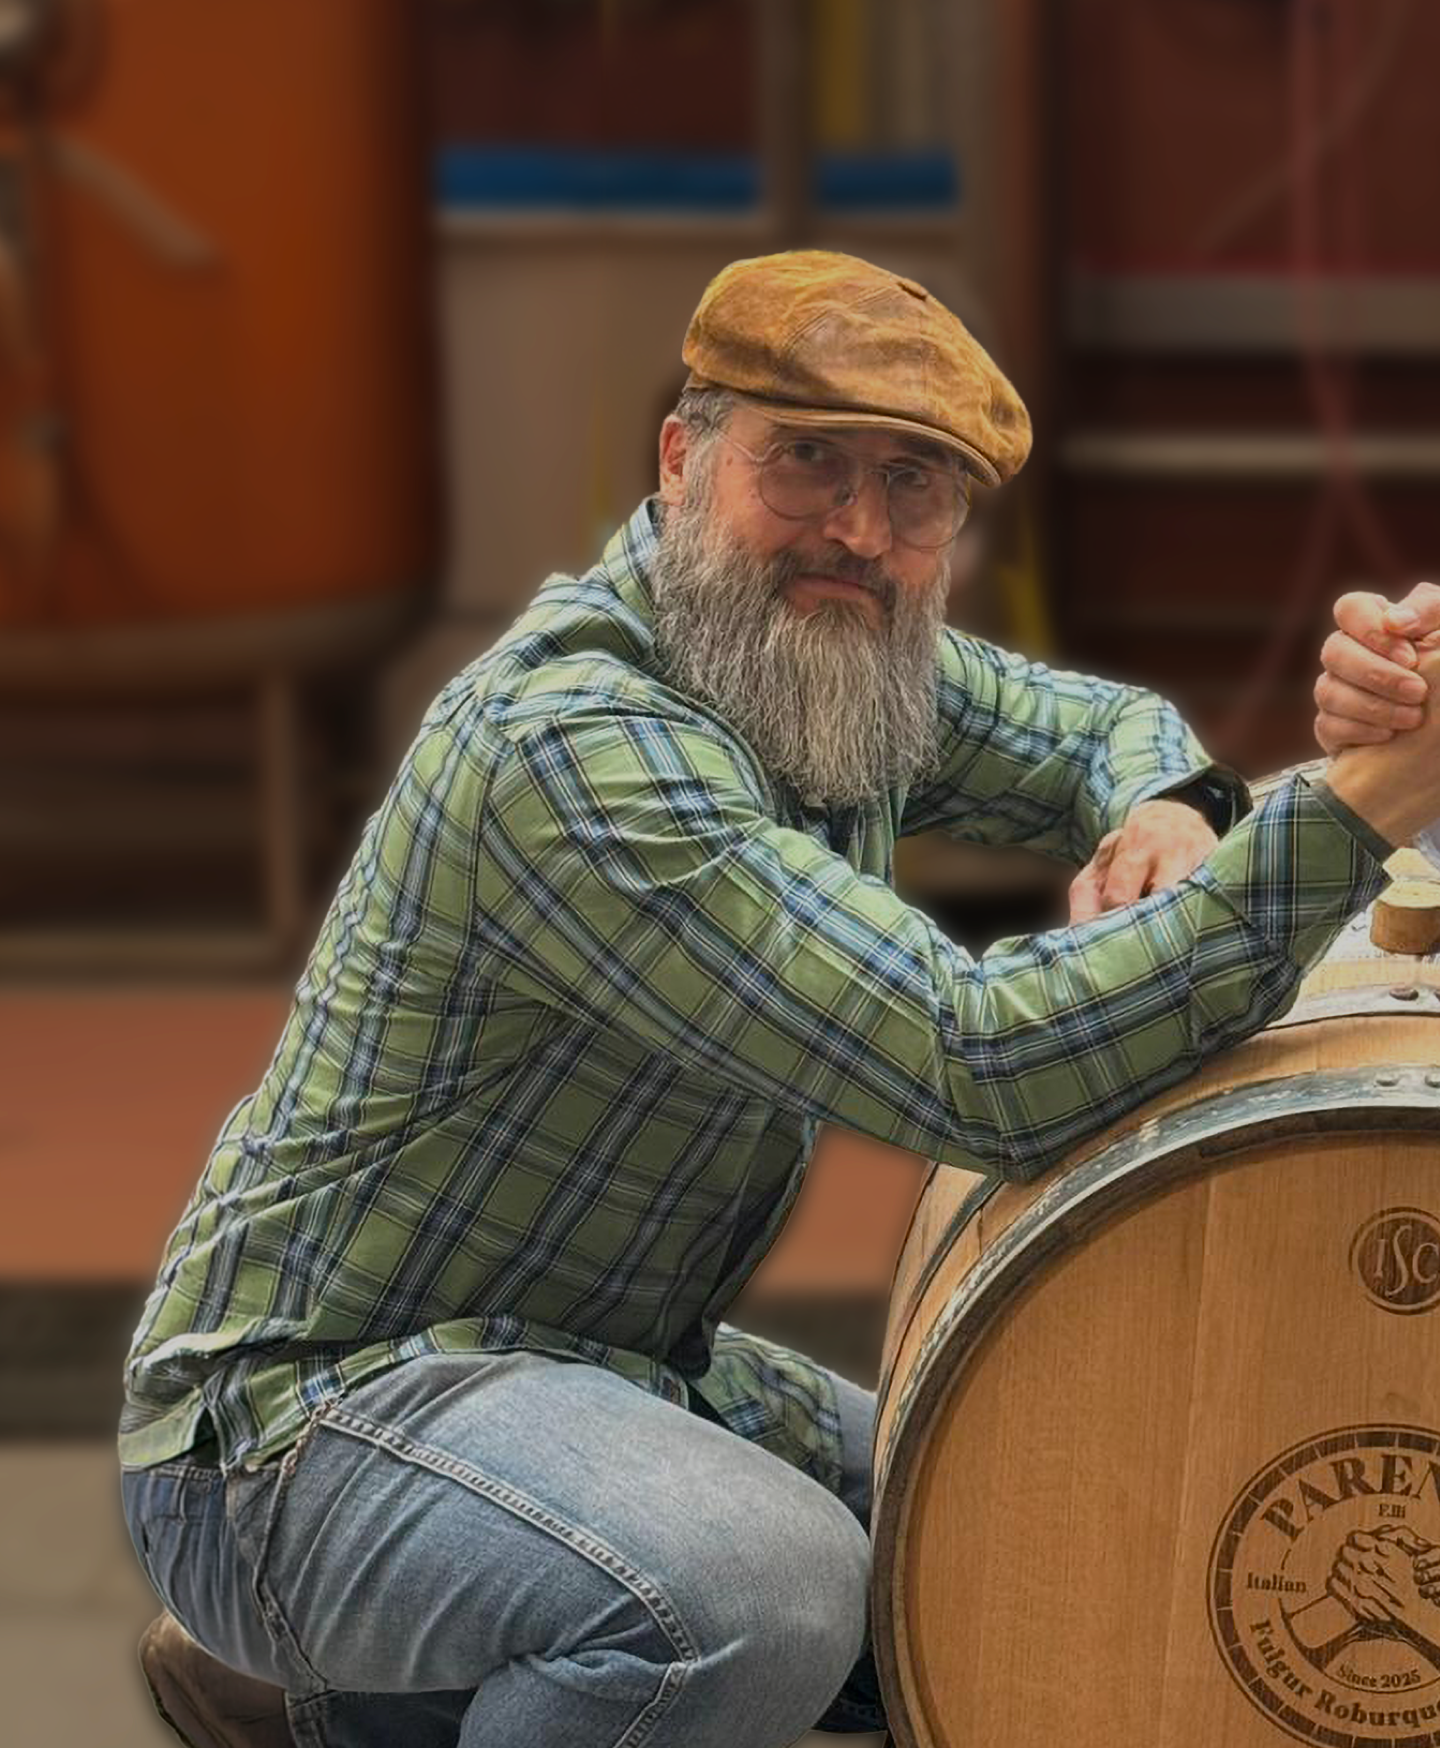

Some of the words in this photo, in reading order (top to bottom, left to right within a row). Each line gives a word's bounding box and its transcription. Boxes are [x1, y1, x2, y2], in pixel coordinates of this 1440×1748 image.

[1246, 1572, 1307, 1594] Italian
[1249, 1619, 1313, 1698] Fulgur
[1336, 1663, 1377, 1689] Since
[1380, 1668, 1421, 1689] 2025
